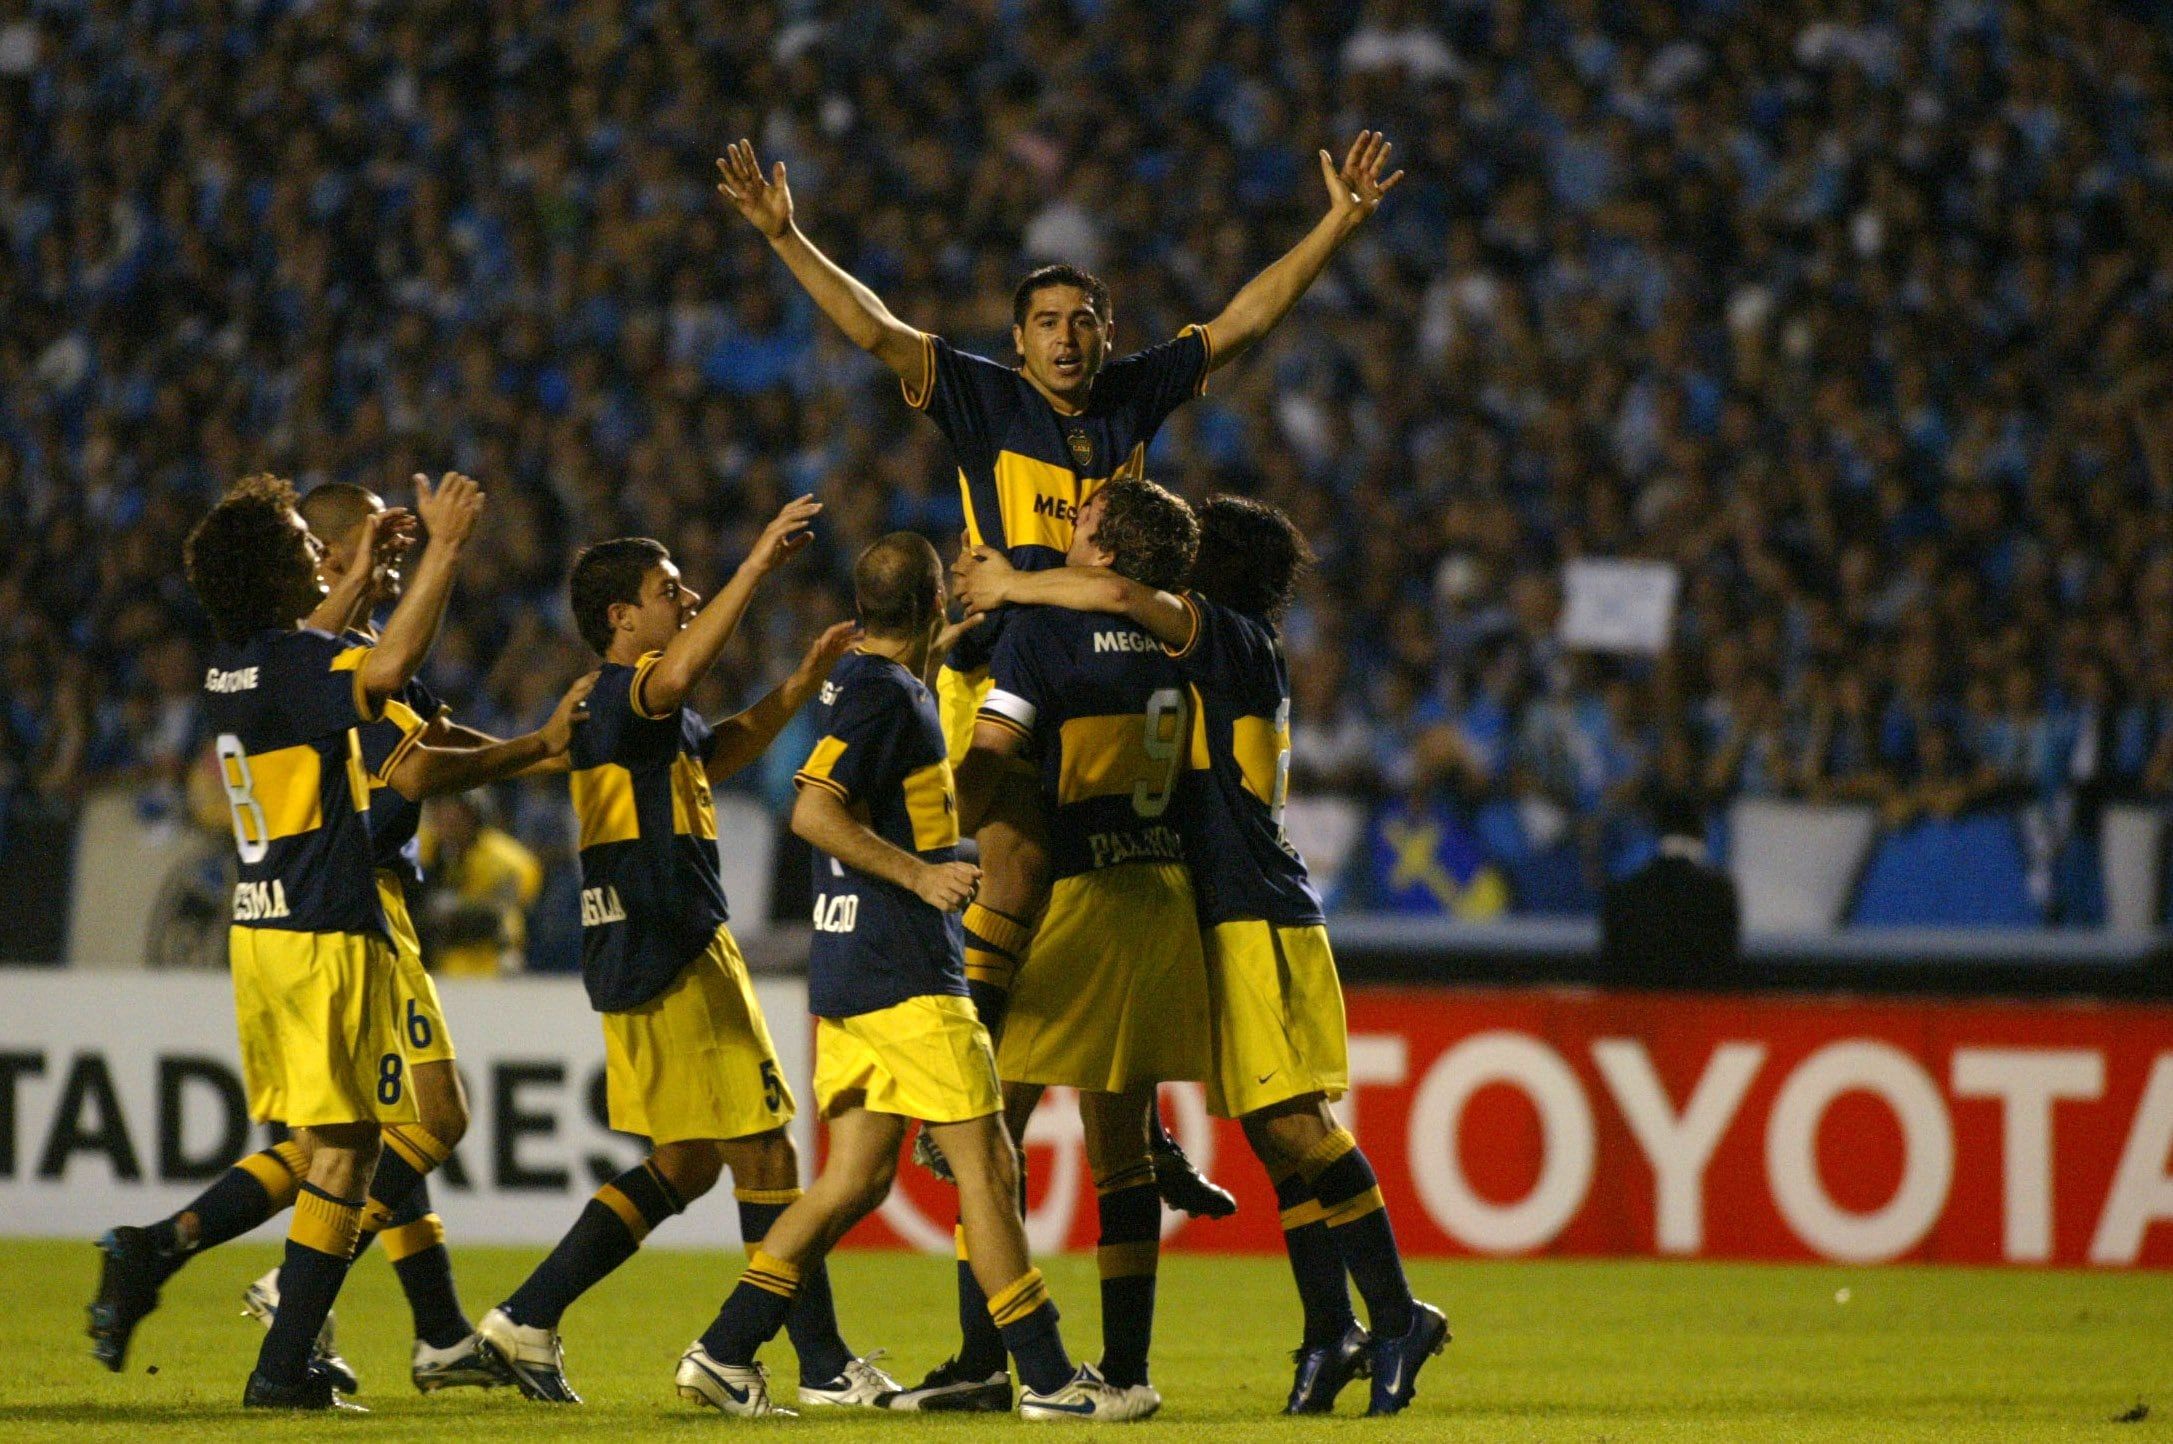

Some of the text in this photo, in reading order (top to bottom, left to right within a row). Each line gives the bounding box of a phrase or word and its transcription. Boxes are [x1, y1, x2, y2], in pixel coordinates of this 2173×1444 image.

[1133, 687, 1186, 817] 9
[216, 733, 269, 864] 8
[407, 998, 432, 1049] 6
[377, 1052, 403, 1106] 8
[760, 1058, 783, 1113] 5
[1340, 1030, 2173, 1264] OYOT
